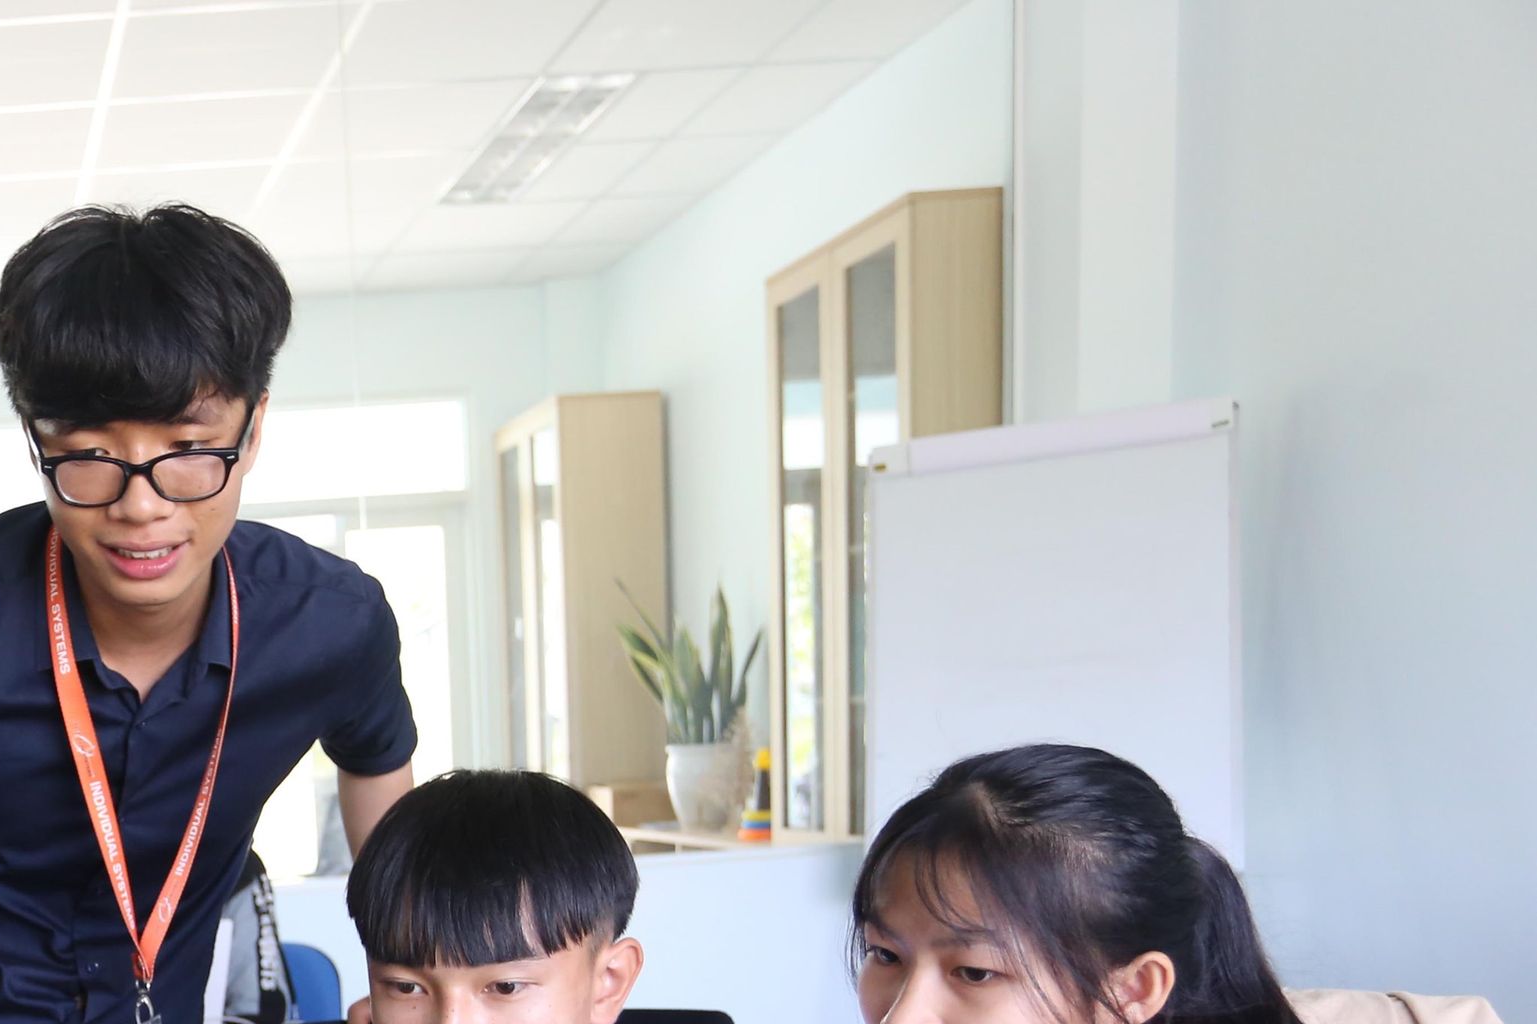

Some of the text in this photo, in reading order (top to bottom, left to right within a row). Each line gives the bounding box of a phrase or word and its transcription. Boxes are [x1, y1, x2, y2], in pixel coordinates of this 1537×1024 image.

[48, 528, 72, 675] NDIVIDUAL SYSTEMS
[88, 780, 119, 862] INDIVIDUAL
[112, 863, 136, 930] SYSTEMS
[175, 798, 206, 876] INDIVIDUAL
